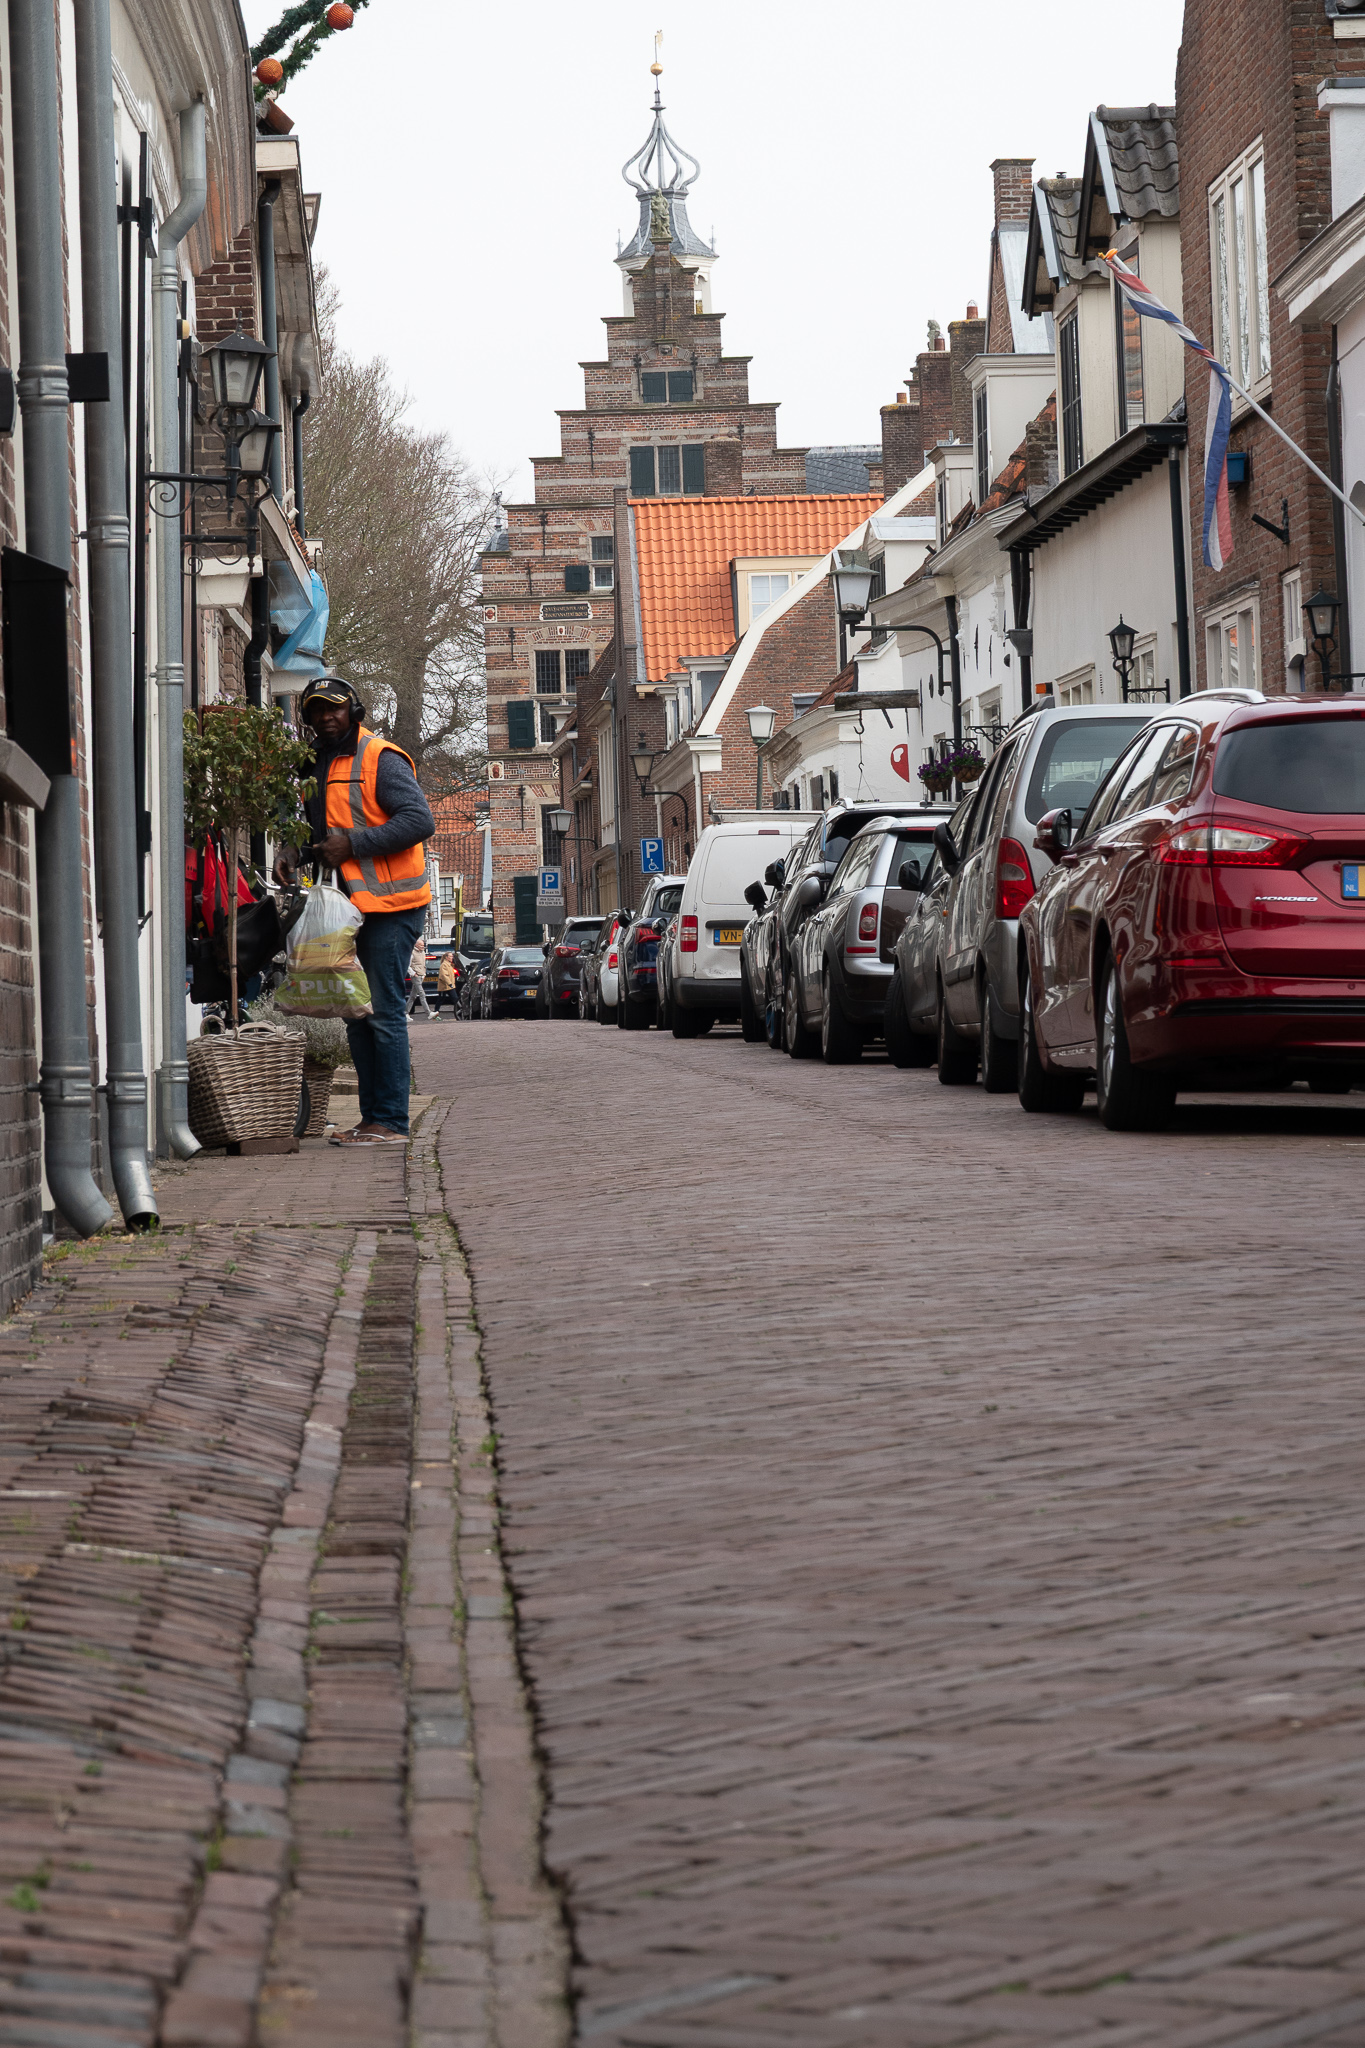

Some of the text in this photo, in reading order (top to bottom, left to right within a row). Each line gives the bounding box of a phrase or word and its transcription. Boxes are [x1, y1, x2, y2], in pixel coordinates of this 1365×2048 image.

[315, 680, 330, 690] CAT
[645, 841, 659, 859] P
[545, 874, 555, 887] P
[1345, 884, 1357, 892] NL
[299, 978, 356, 995] PLUS
